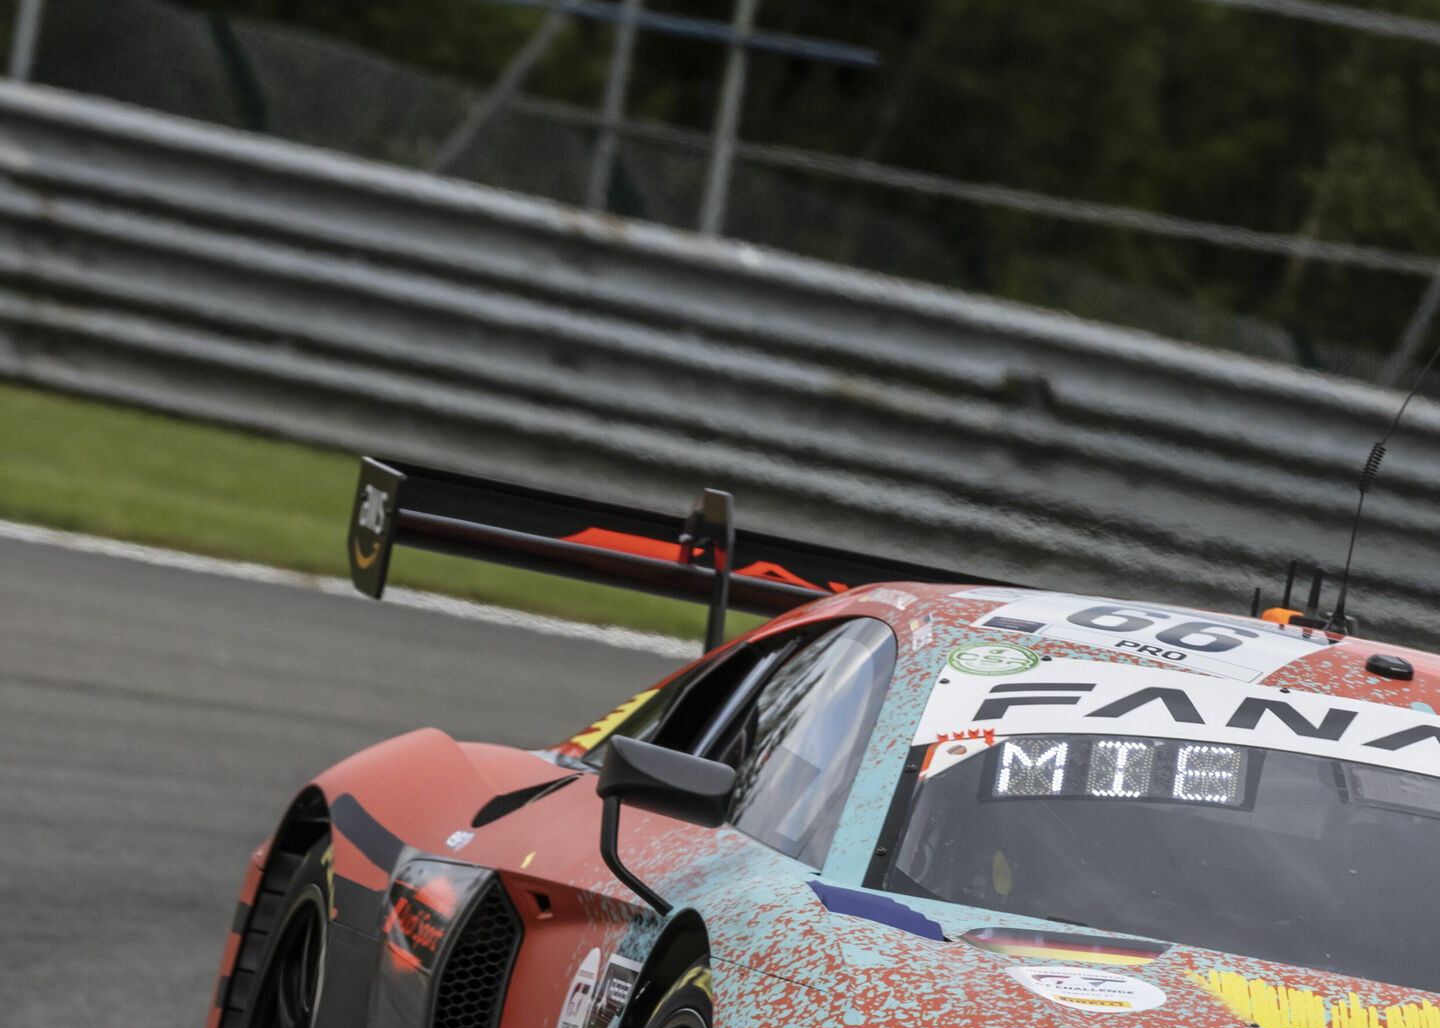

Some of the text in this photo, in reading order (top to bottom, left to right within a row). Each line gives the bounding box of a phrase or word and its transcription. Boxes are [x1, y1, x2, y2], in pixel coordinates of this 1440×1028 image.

[1066, 605, 1259, 652] 66
[1114, 639, 1187, 661] PRO
[997, 740, 1236, 802] MIE
